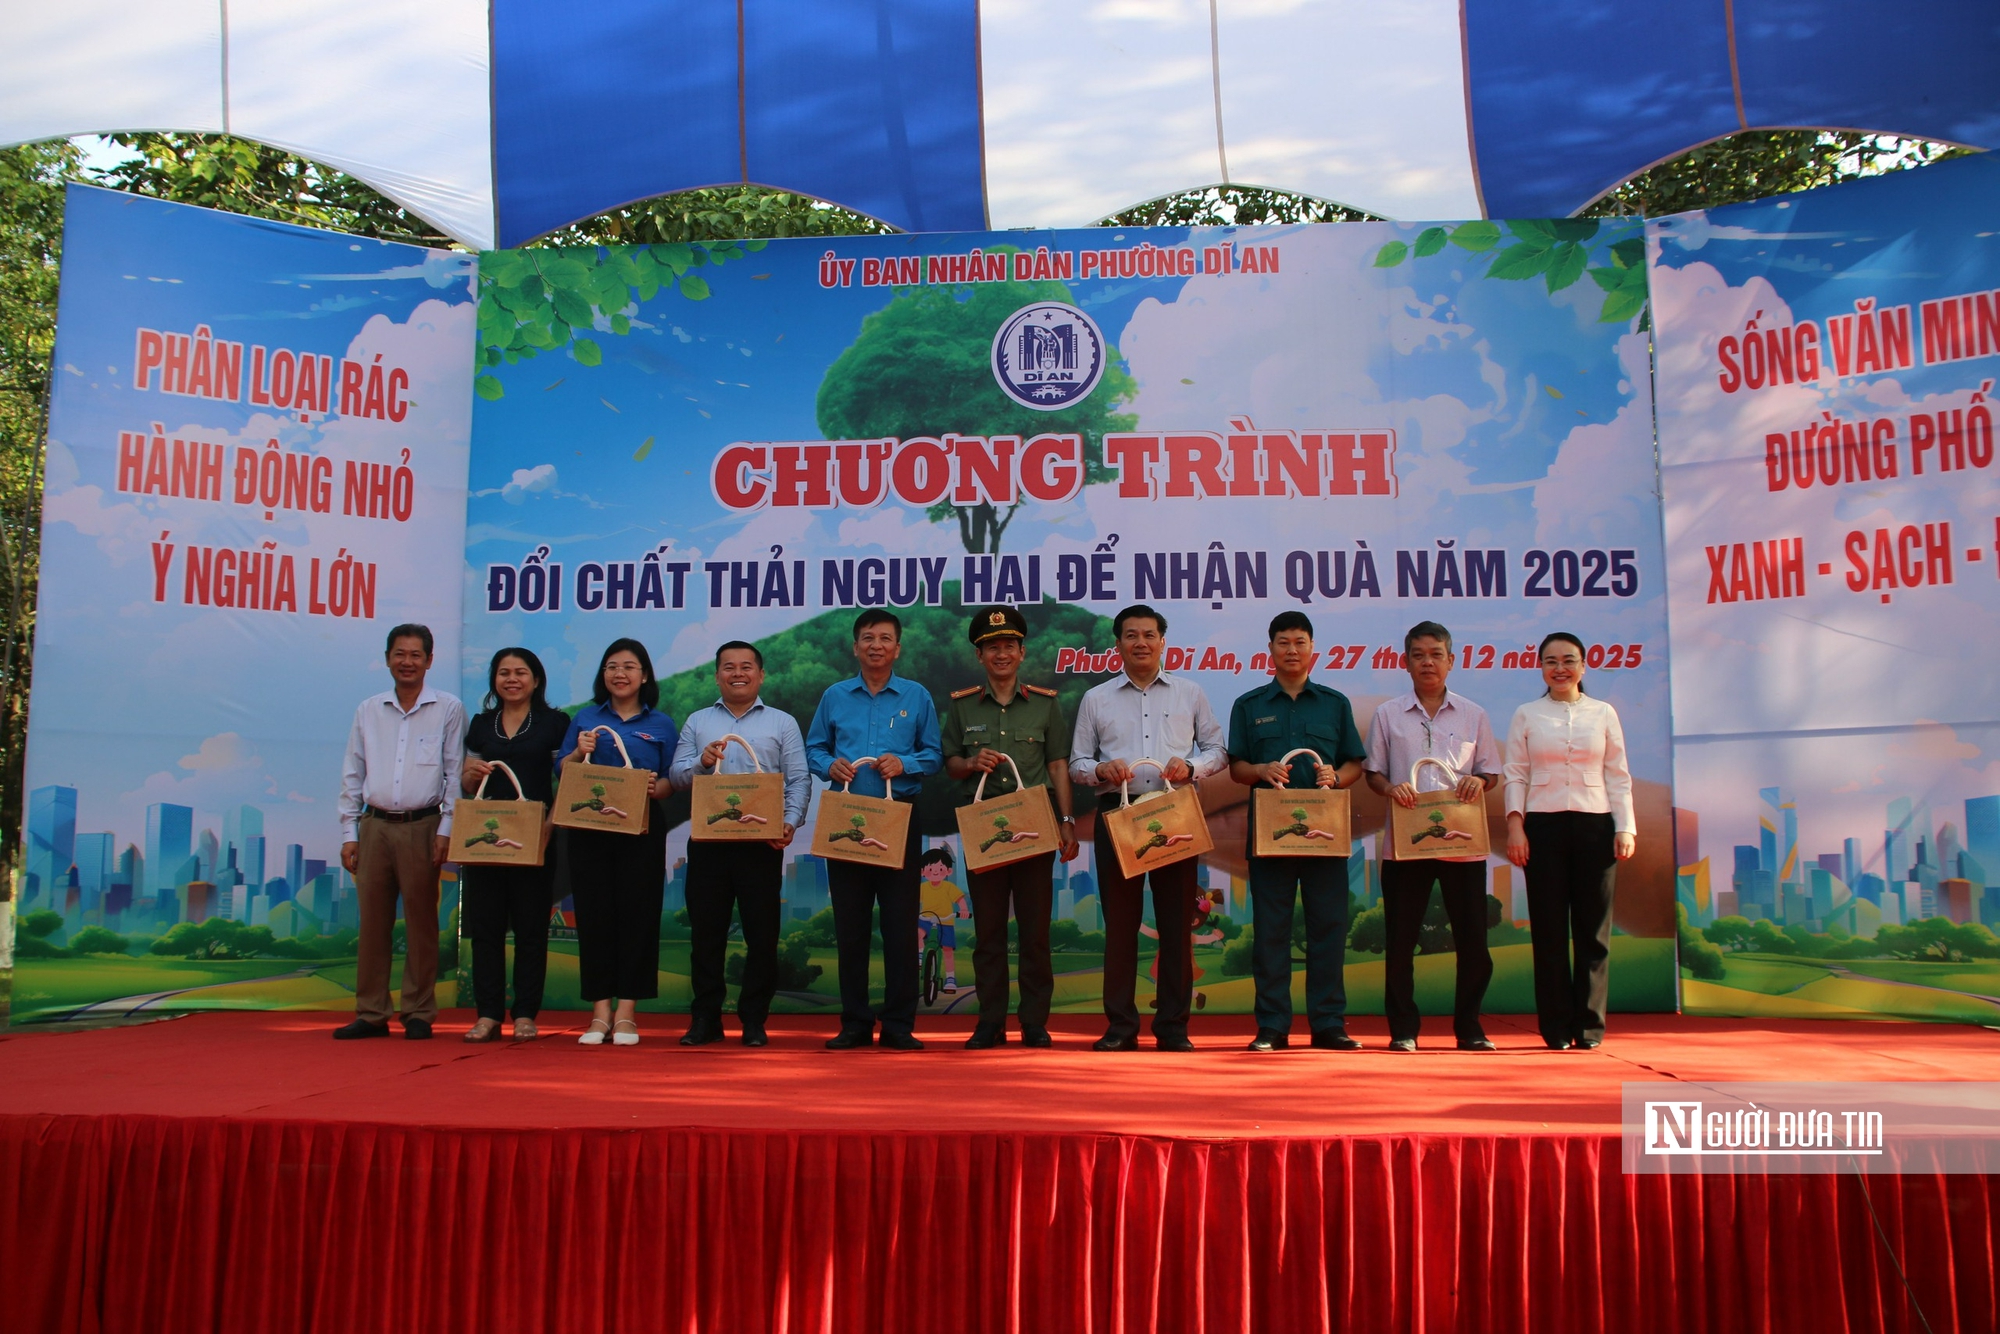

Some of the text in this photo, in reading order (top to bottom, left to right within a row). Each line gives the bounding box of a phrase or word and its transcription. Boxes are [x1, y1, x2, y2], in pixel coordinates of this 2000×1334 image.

[821, 242, 1279, 287] ỦY BAN NHÂN DÂN PHƯỜNG DĨ AN
[138, 327, 409, 423] PHÂN LOẠI RÁC
[1024, 371, 1073, 381] DĨ AN
[1717, 310, 1819, 393] SỐNG
[1828, 300, 1912, 377] VĂN
[119, 424, 414, 522] HÀNH ĐỘNG NHỎ
[714, 420, 1392, 509] CHƯƠNG TRÌNH
[1764, 381, 1994, 492] ĐƯỜNG PHỐ
[151, 530, 377, 619] Ý NGHĨA LỚN
[487, 533, 1638, 612] ĐỔI CHẤT THẢI NGUY HẠI ĐỂ NHẬN QUÀ NĂM 2025
[1705, 536, 1806, 604] XANH
[1843, 521, 1953, 604] SẠCH
[1057, 646, 1124, 672] Phườ
[1164, 647, 1195, 671] Dĩ
[1198, 646, 1243, 675] An,
[1325, 645, 1366, 670] 27
[1462, 644, 1496, 669] 12
[1502, 644, 1542, 669] nă
[1585, 644, 1643, 669] 025
